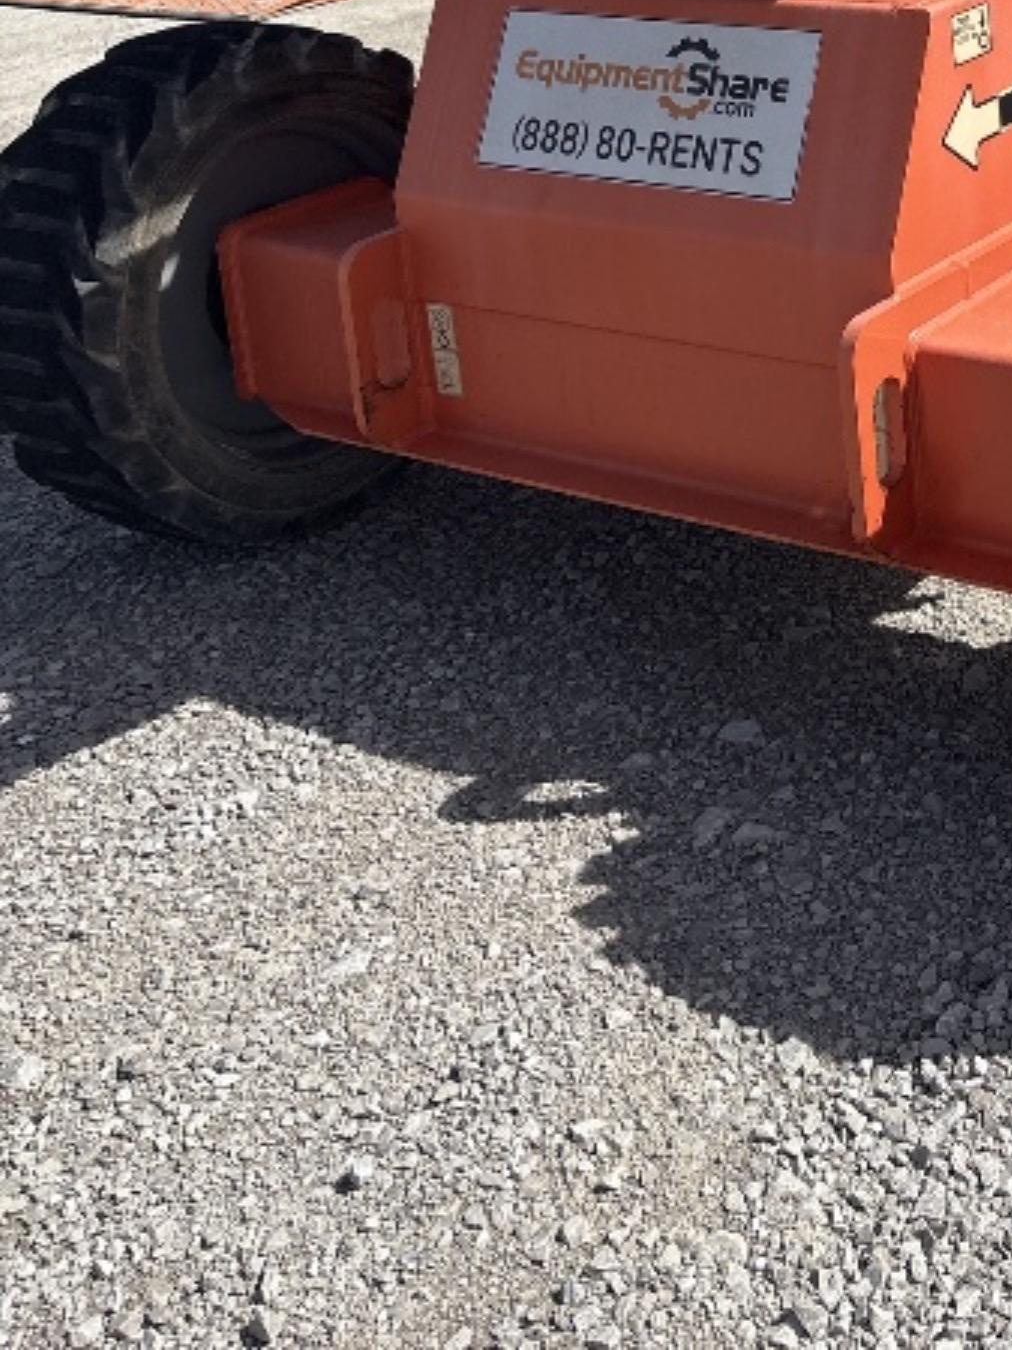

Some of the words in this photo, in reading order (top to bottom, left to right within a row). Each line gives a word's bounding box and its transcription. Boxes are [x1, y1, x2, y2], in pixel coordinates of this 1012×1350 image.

[515, 49, 790, 103] EquipmentShare
[512, 114, 589, 160] (888)
[595, 125, 764, 178] 80-RENTS
